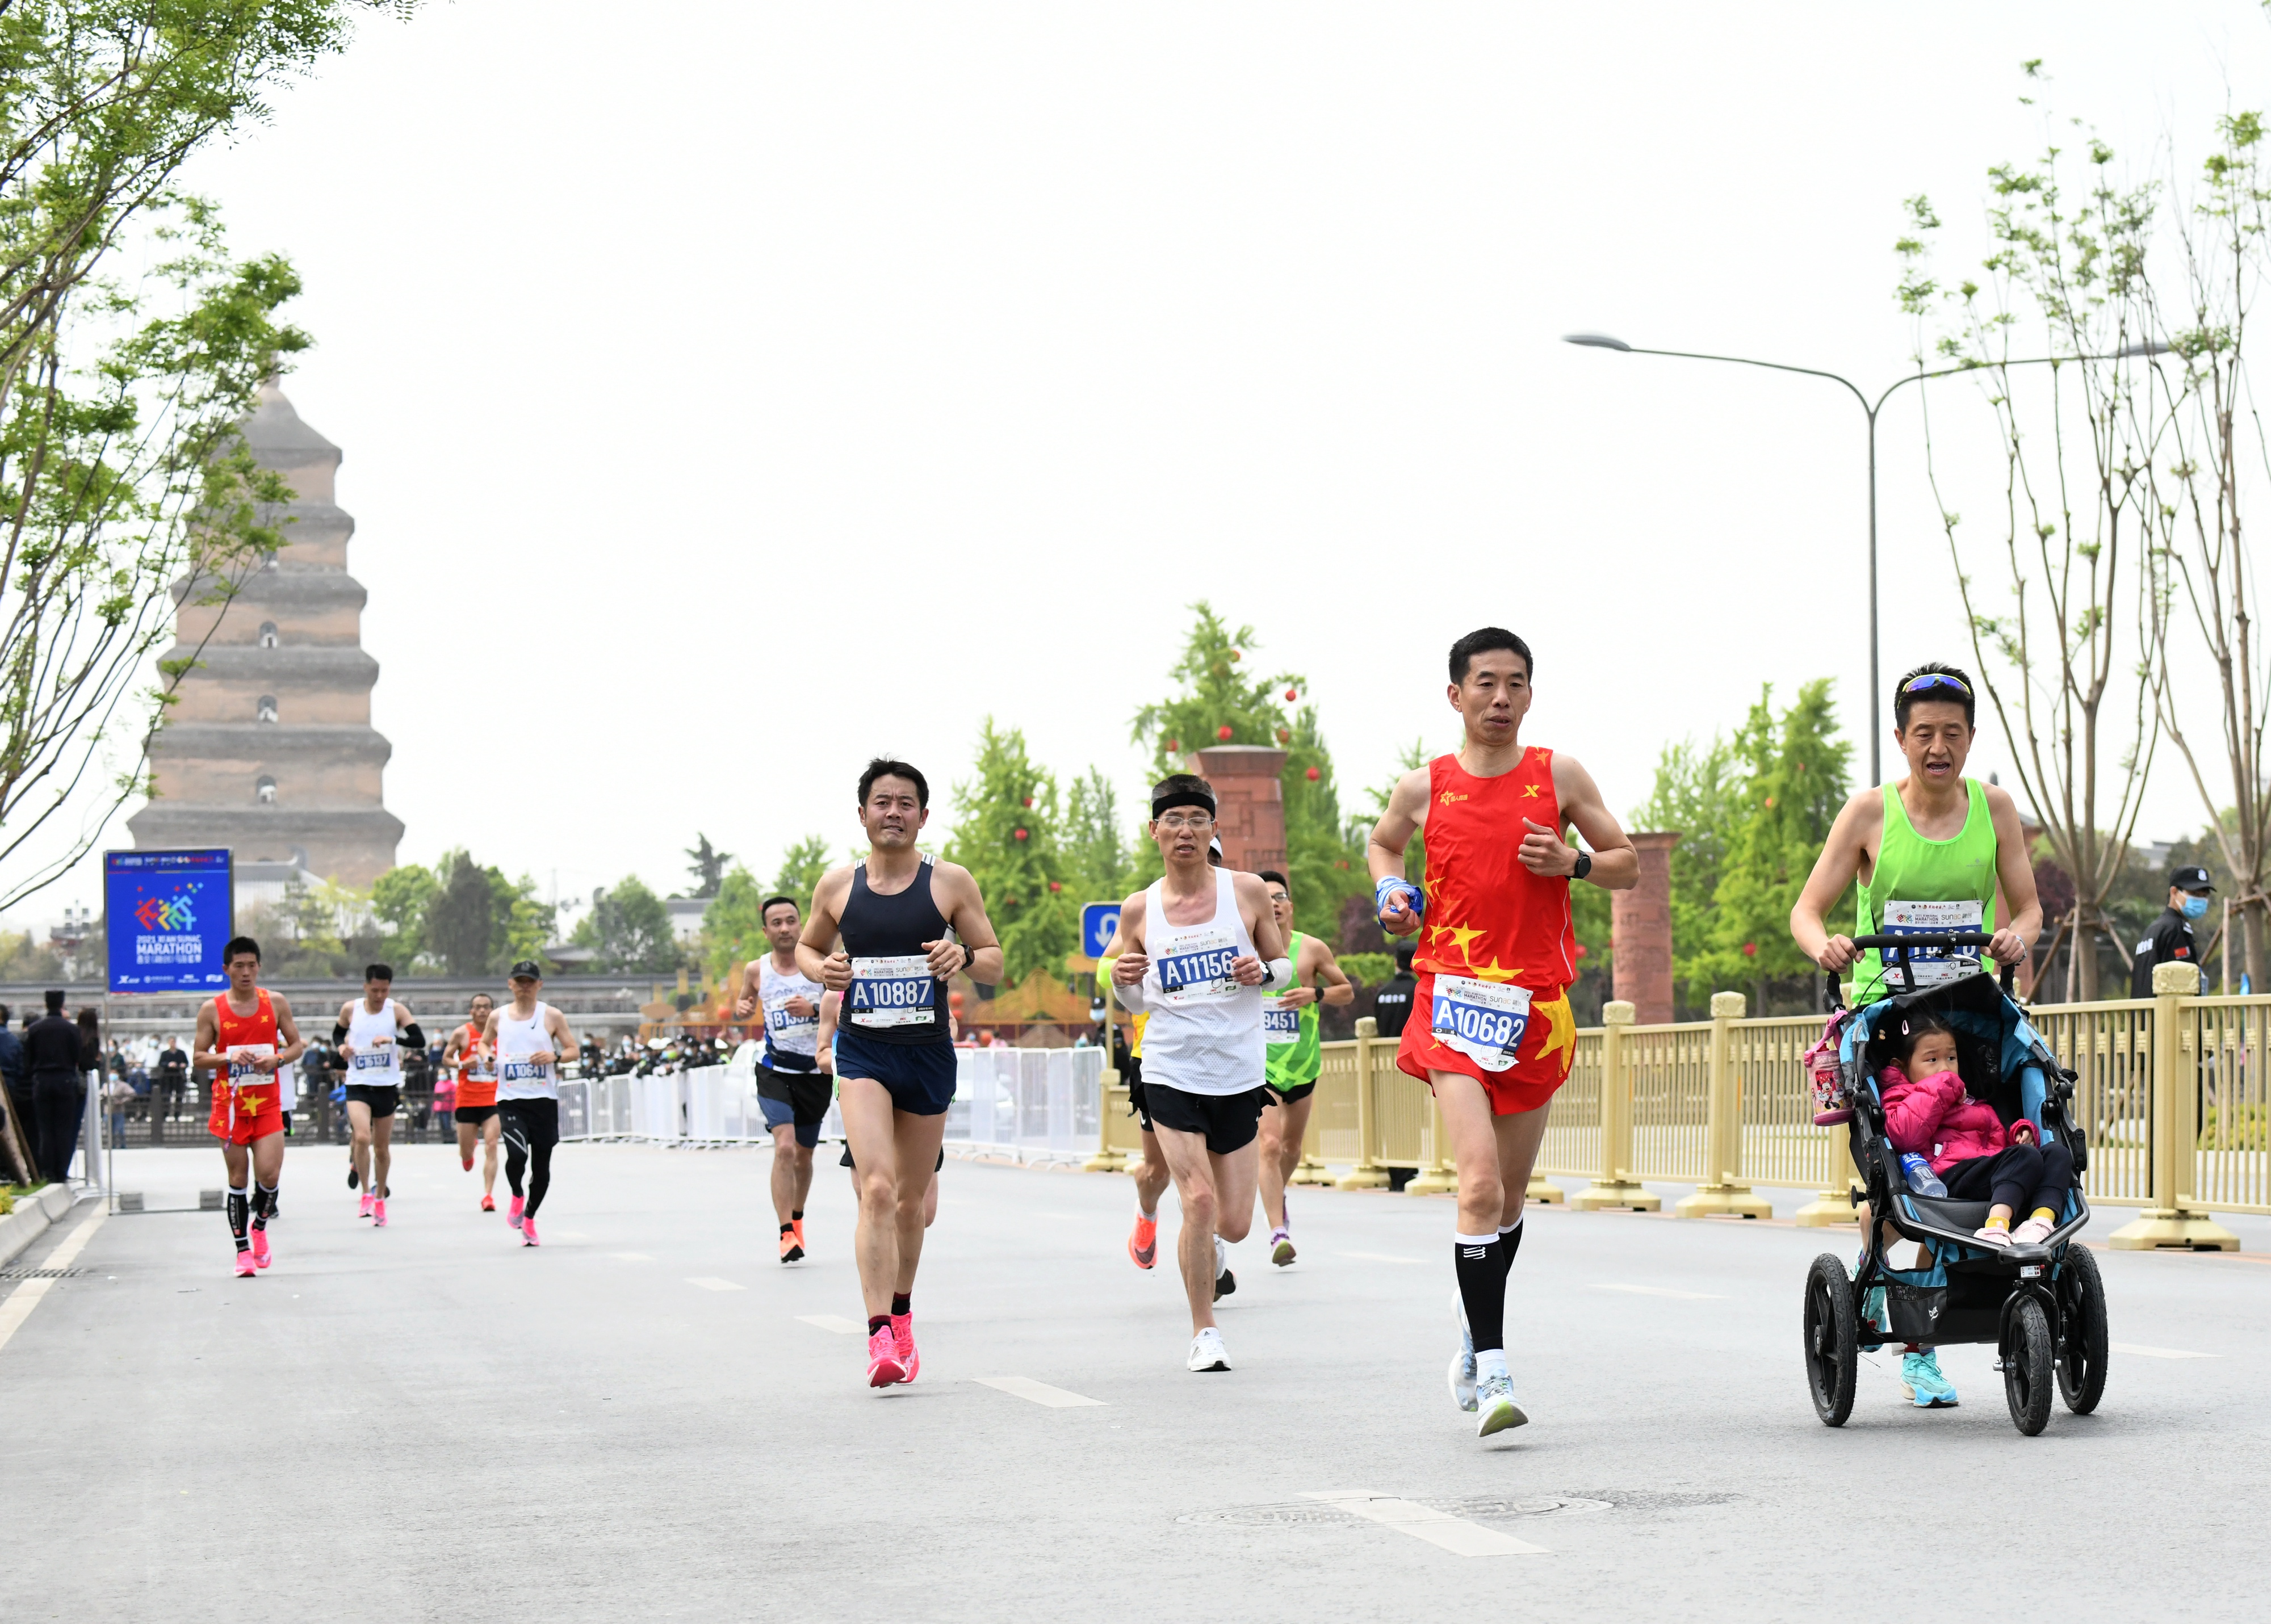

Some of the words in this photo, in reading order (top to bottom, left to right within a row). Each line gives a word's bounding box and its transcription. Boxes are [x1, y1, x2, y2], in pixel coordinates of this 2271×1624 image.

[136, 942, 202, 955] MARATHON
[1167, 951, 1234, 985] A11156
[853, 979, 931, 1006] A10887
[1464, 993, 1487, 1001] MARATHON
[1489, 996, 1511, 1005] sunac
[1435, 1000, 1524, 1048] A10682
